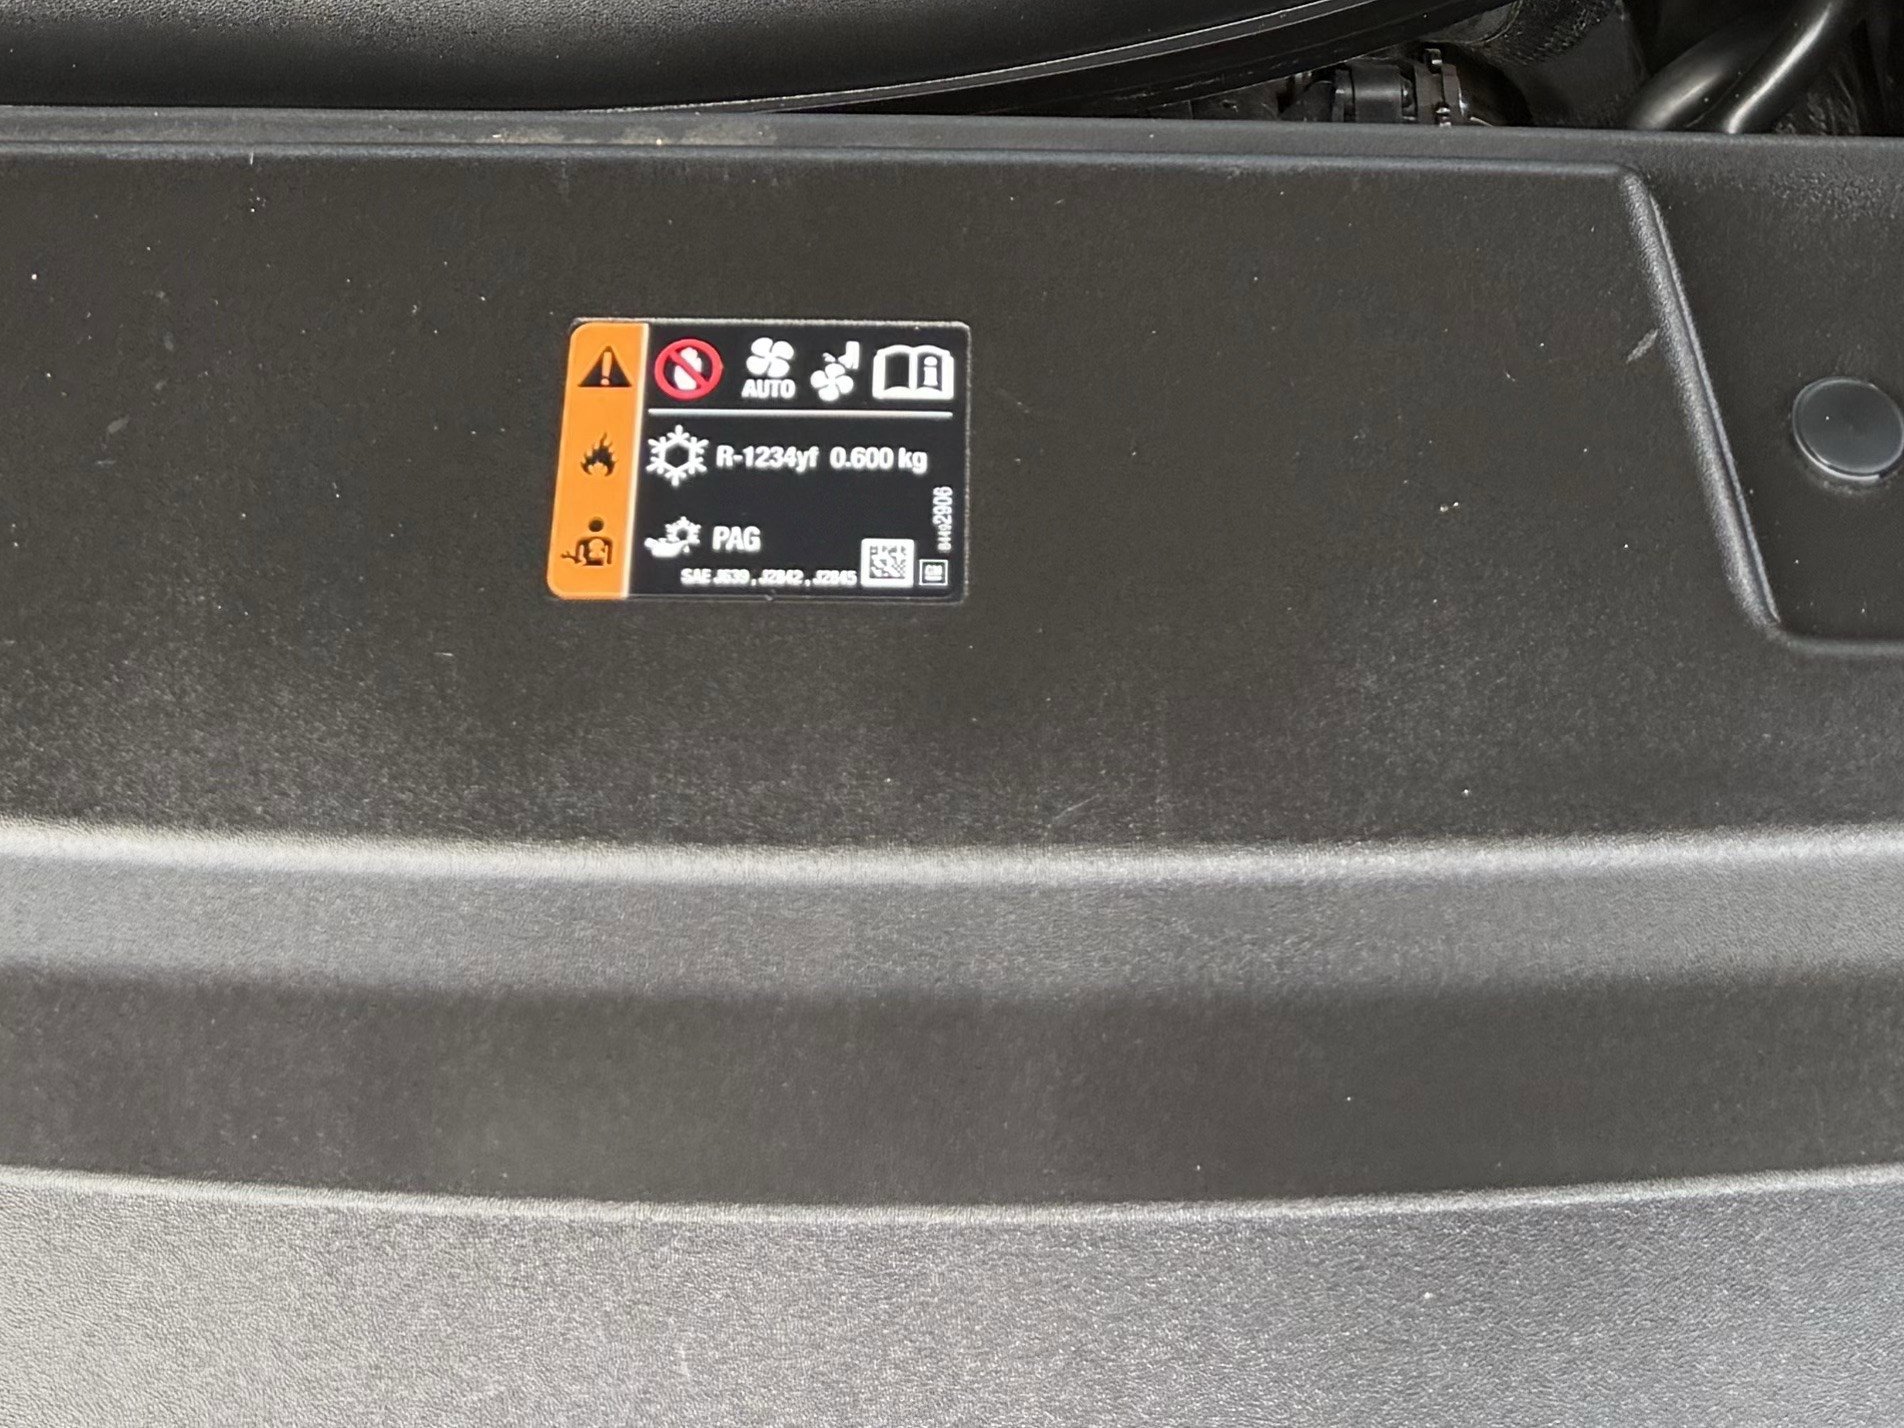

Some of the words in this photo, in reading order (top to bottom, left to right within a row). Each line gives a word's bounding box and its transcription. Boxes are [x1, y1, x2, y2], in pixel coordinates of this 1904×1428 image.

[741, 379, 796, 399] AUTO
[715, 445, 819, 475] R-1234yf
[829, 446, 893, 471] 0.600
[897, 446, 928, 474] kg
[711, 526, 761, 552] PAG
[680, 568, 712, 585] SAE
